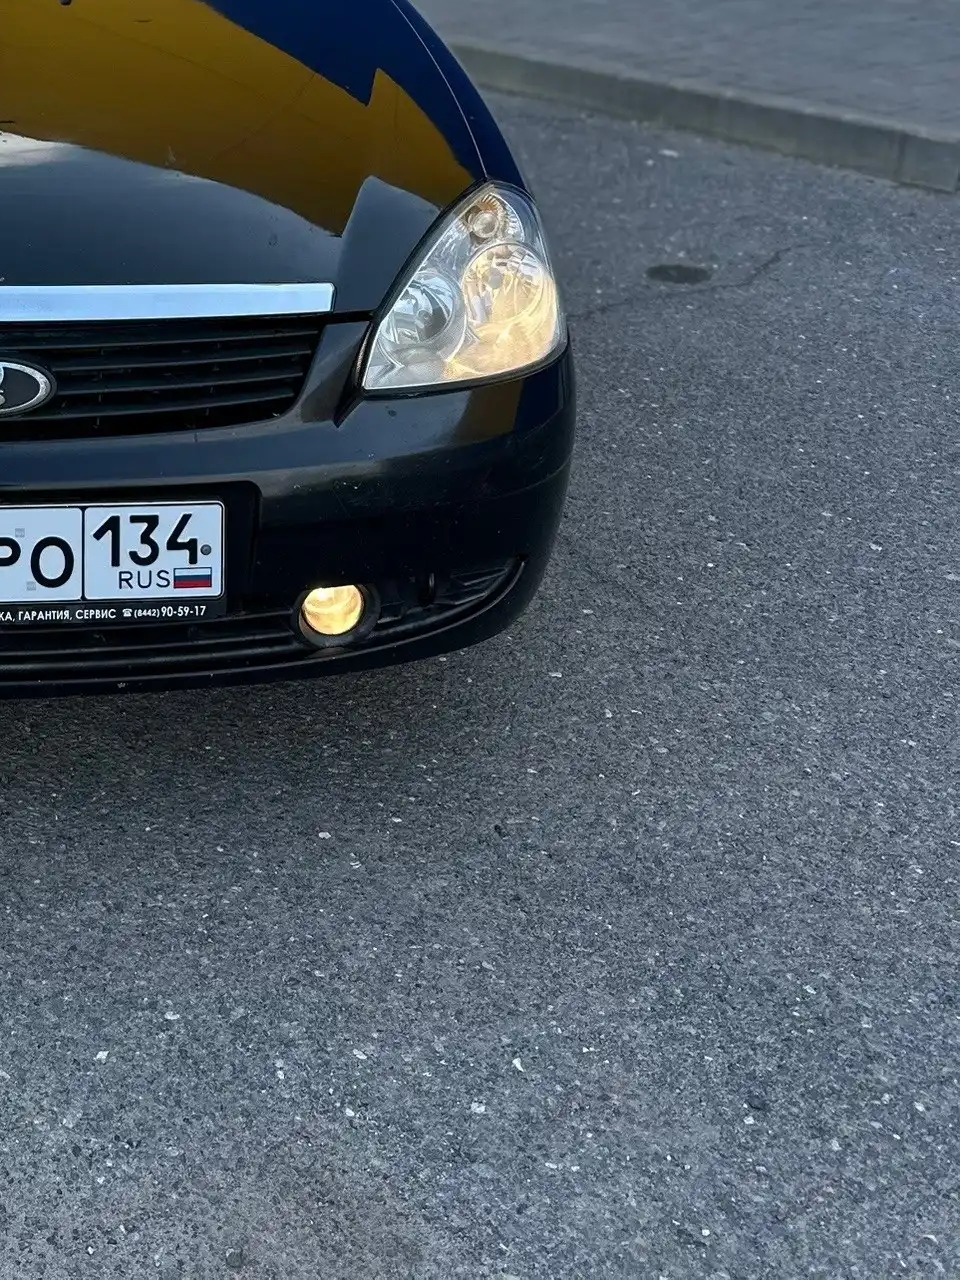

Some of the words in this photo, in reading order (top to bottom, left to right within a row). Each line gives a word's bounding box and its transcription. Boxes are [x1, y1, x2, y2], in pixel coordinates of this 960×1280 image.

[92, 513, 199, 568] 134
[119, 569, 171, 590] RUS
[18, 609, 73, 622] ГАРАНТИЯ,
[75, 608, 117, 620] СЕРВИС
[161, 606, 207, 618] 90-59-17
